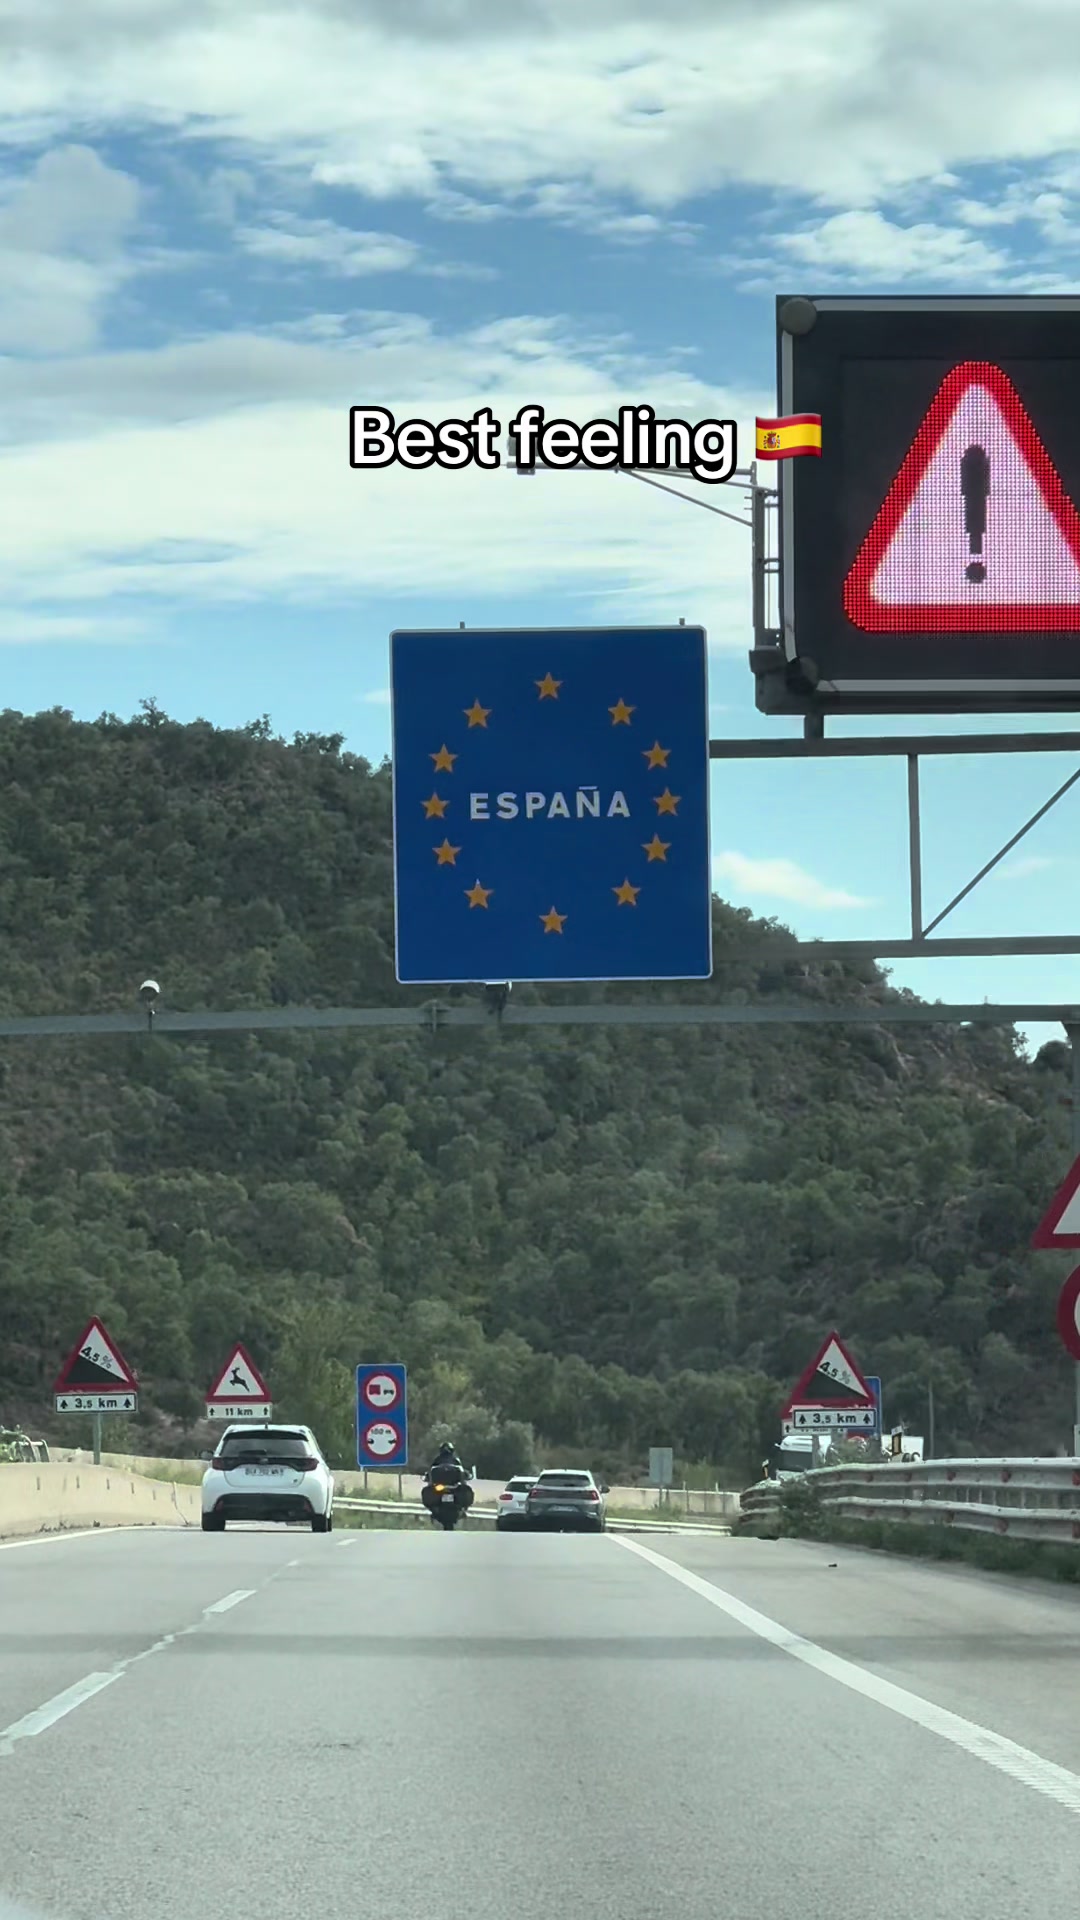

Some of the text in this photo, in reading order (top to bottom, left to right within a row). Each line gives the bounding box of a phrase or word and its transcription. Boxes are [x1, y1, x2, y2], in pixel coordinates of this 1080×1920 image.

[470, 786, 631, 820] ESPAÑA
[98, 1397, 117, 1409] km
[225, 1407, 253, 1416] 11 km
[837, 1413, 857, 1424] km
